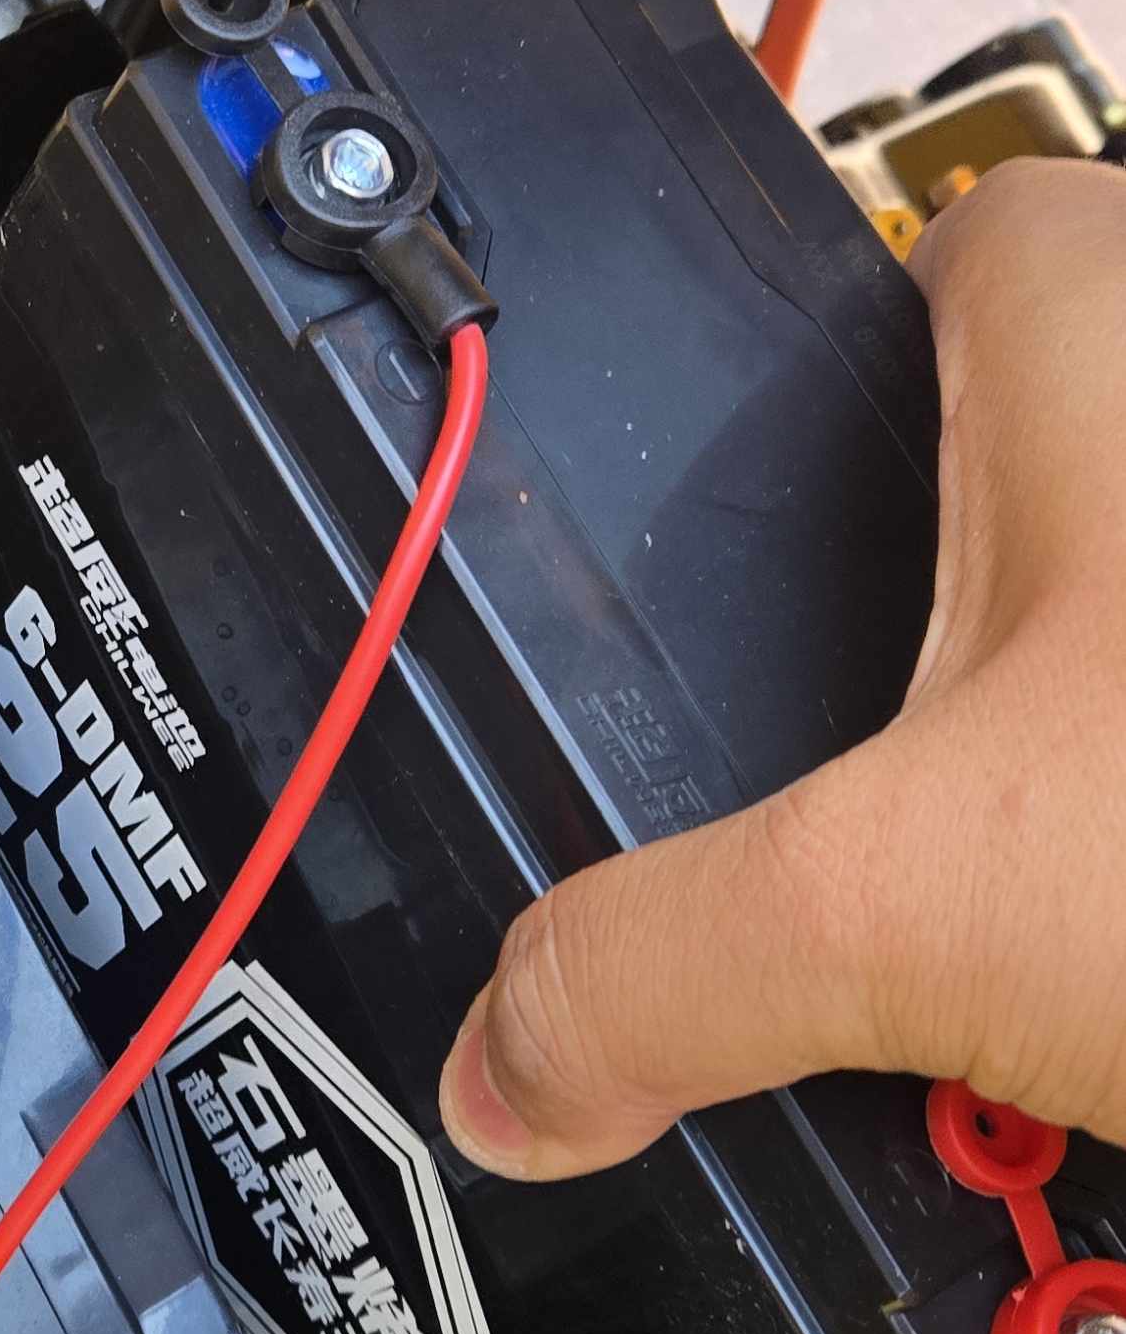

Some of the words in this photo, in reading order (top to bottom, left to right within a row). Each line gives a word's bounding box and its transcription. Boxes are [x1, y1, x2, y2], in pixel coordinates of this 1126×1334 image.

[4, 584, 206, 901] 6-DMF
[19, 455, 205, 766] 超威电池
[79, 595, 190, 773] CHILWEE
